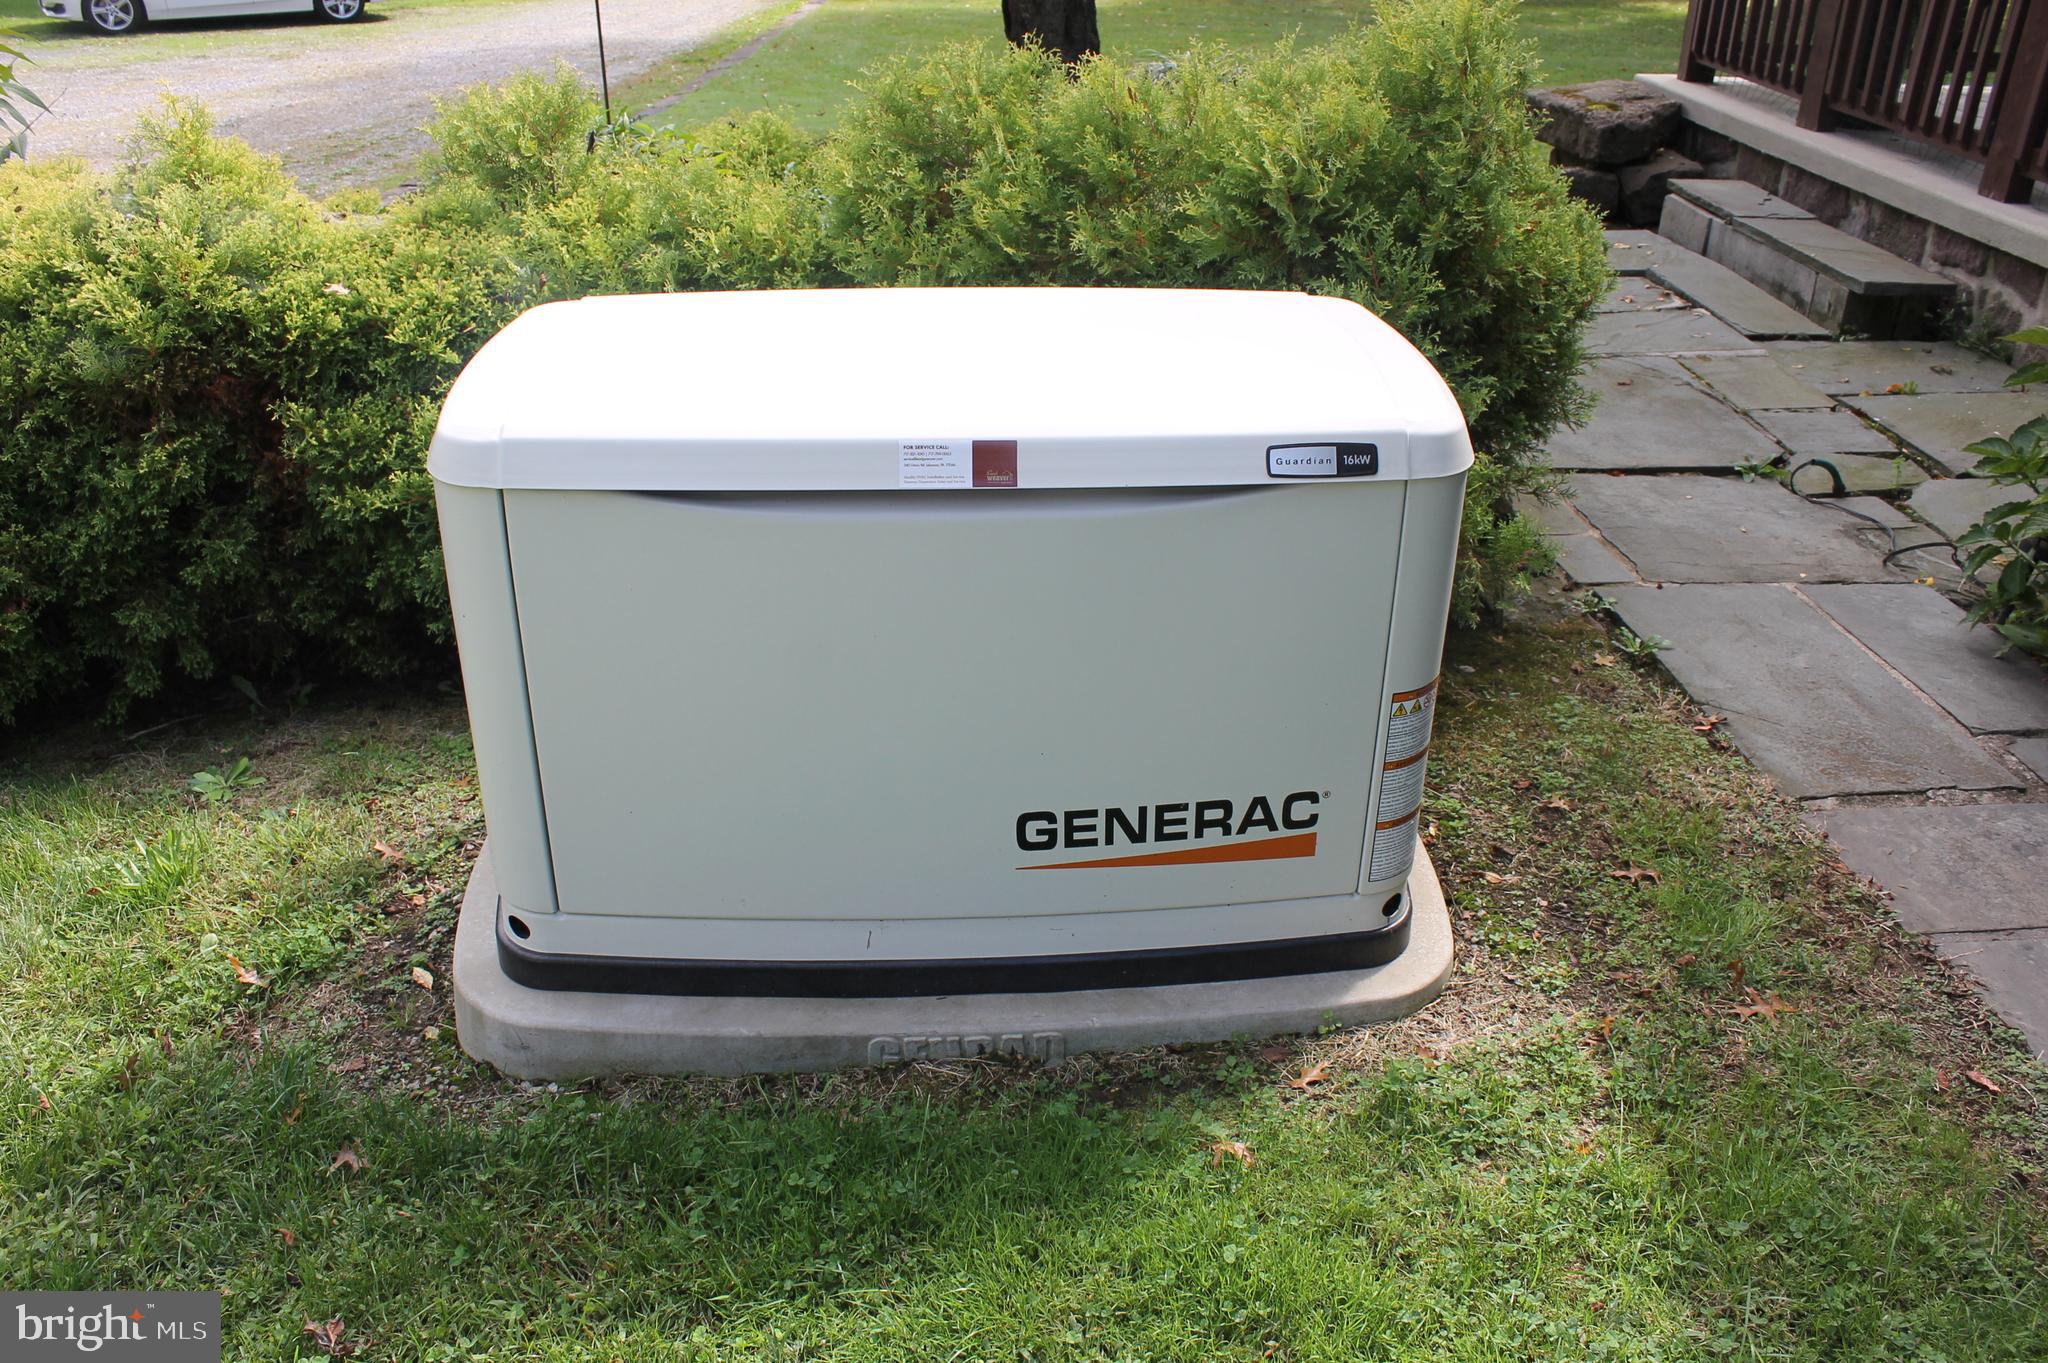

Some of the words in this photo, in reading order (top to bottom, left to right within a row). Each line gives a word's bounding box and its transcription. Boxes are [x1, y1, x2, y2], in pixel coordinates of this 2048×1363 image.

[1275, 456, 1332, 466] Guardian
[1343, 455, 1371, 465] 16kW
[1016, 790, 1320, 852] GENERAC
